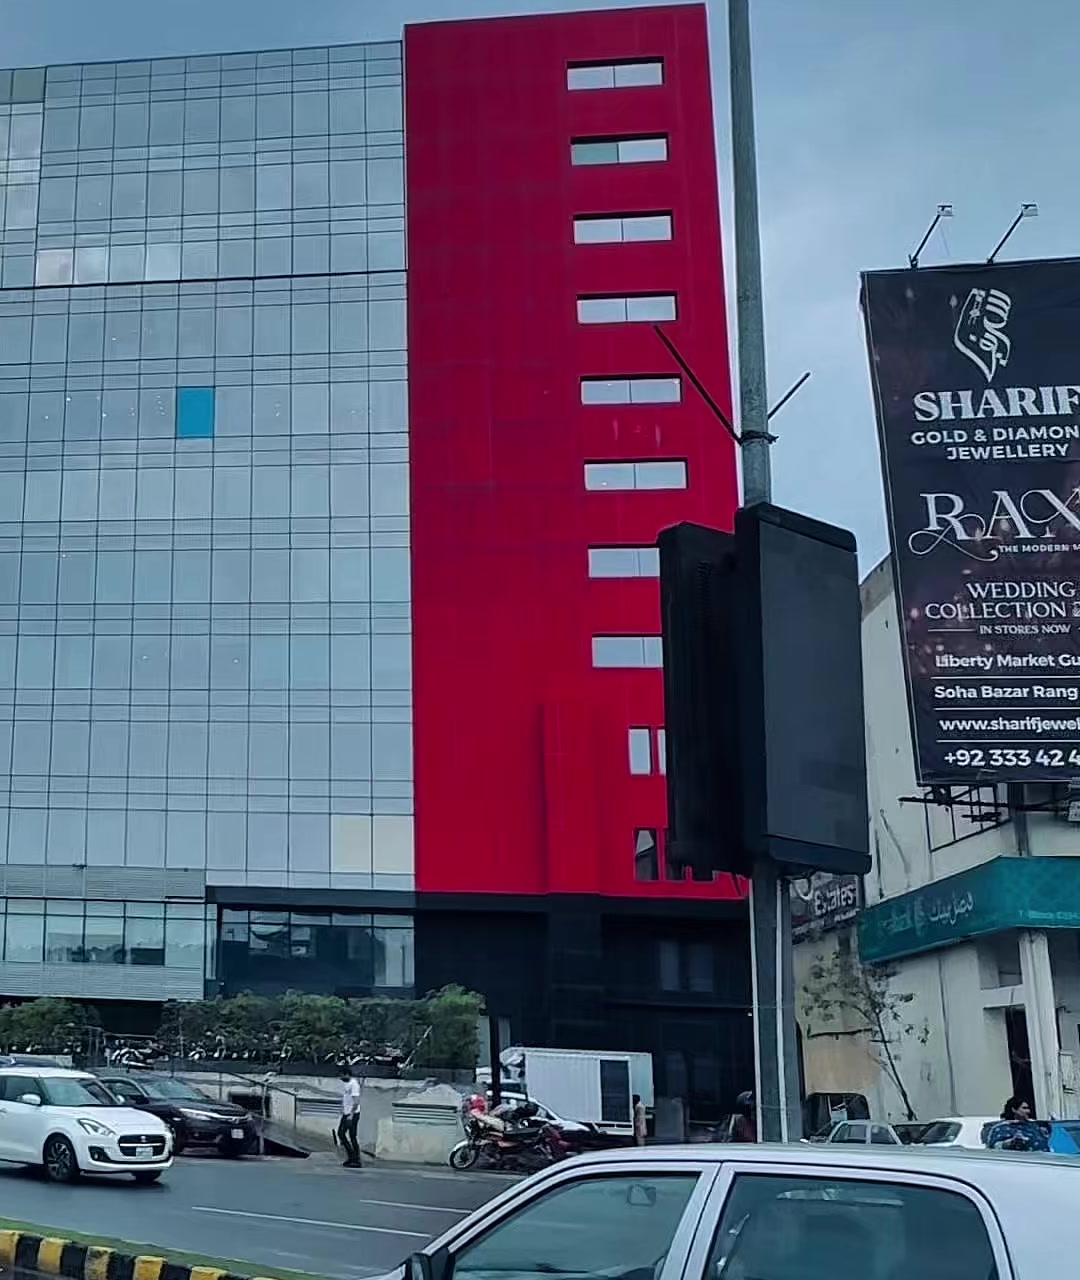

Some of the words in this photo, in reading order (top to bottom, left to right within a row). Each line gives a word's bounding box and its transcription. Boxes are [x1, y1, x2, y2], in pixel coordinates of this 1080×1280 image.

[913, 385, 1080, 421] SHARIF
[911, 430, 968, 445] GOLD
[974, 428, 987, 442] &
[946, 443, 1069, 460] JEWELLERY
[999, 544, 1018, 553] THE
[1022, 544, 1069, 553] MODERN
[966, 581, 1076, 599] WEDDING
[925, 601, 1067, 619] COLLECTION
[980, 625, 992, 634] IN
[995, 624, 1039, 634] STORES
[1042, 624, 1071, 634] NOW
[935, 653, 993, 670] Liberty
[997, 653, 1056, 667] Market
[934, 685, 978, 699] Soha
[981, 685, 1029, 698] Bazar
[1033, 685, 1078, 700] Rang
[944, 749, 986, 767] +92
[989, 749, 1031, 767] 333
[1035, 749, 1065, 767] 42
